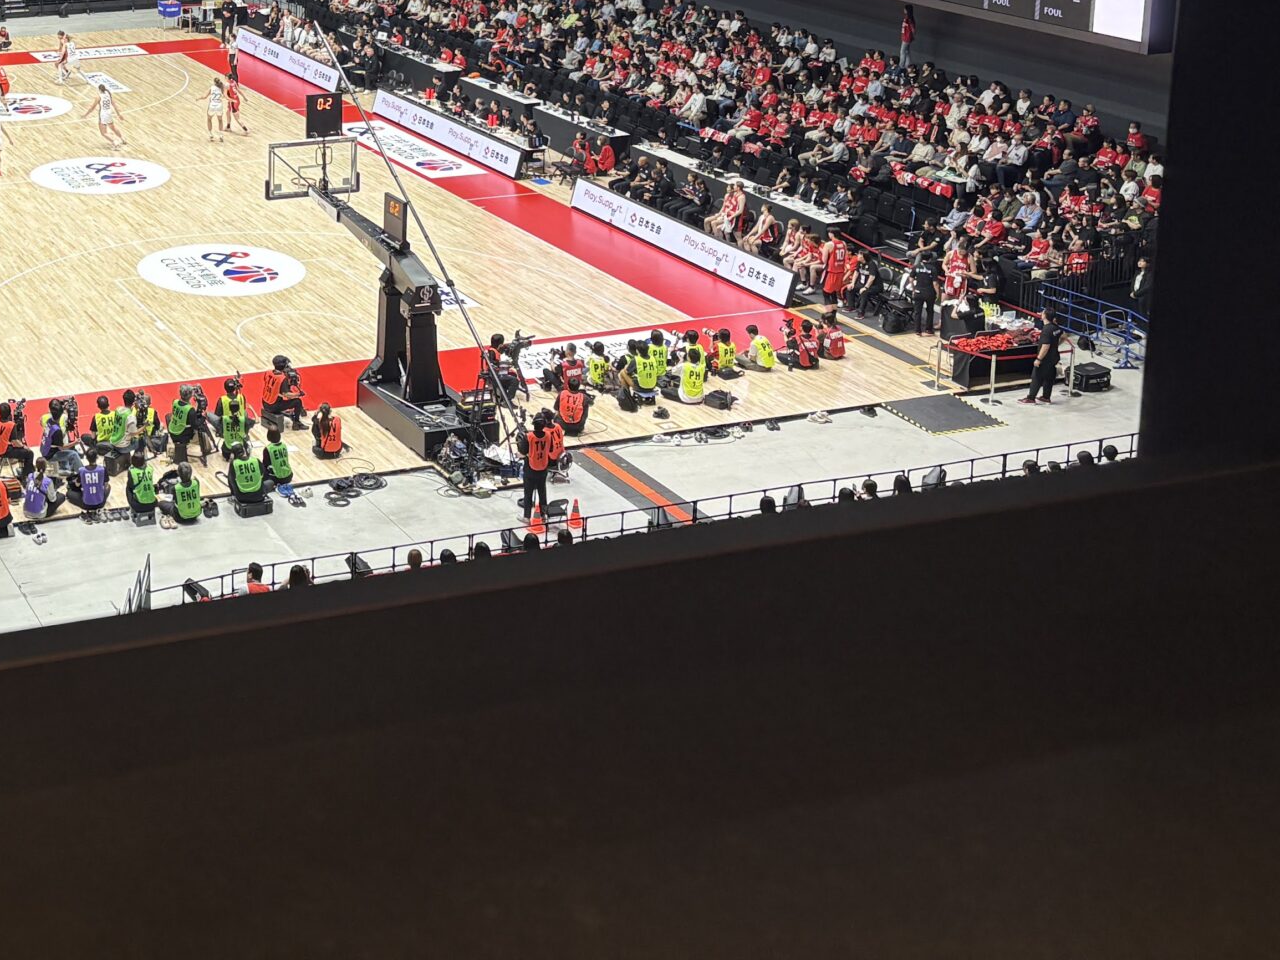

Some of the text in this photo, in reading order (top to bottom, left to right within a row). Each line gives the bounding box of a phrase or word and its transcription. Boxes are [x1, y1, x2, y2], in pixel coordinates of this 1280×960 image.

[1044, 7, 1062, 17] FOUL
[490, 150, 508, 164] 日本生命
[638, 217, 662, 235] 日本生命
[836, 249, 844, 260] 10
[747, 267, 775, 287] 日本生命
[653, 350, 664, 358] PH
[724, 348, 735, 357] PH
[643, 361, 654, 371] PH
[689, 370, 700, 380] PH
[102, 418, 114, 427] PH
[535, 441, 546, 451] TV
[274, 448, 287, 458] ENG
[238, 463, 255, 475] ENG
[85, 472, 99, 484] RH
[181, 490, 197, 502] ENG
